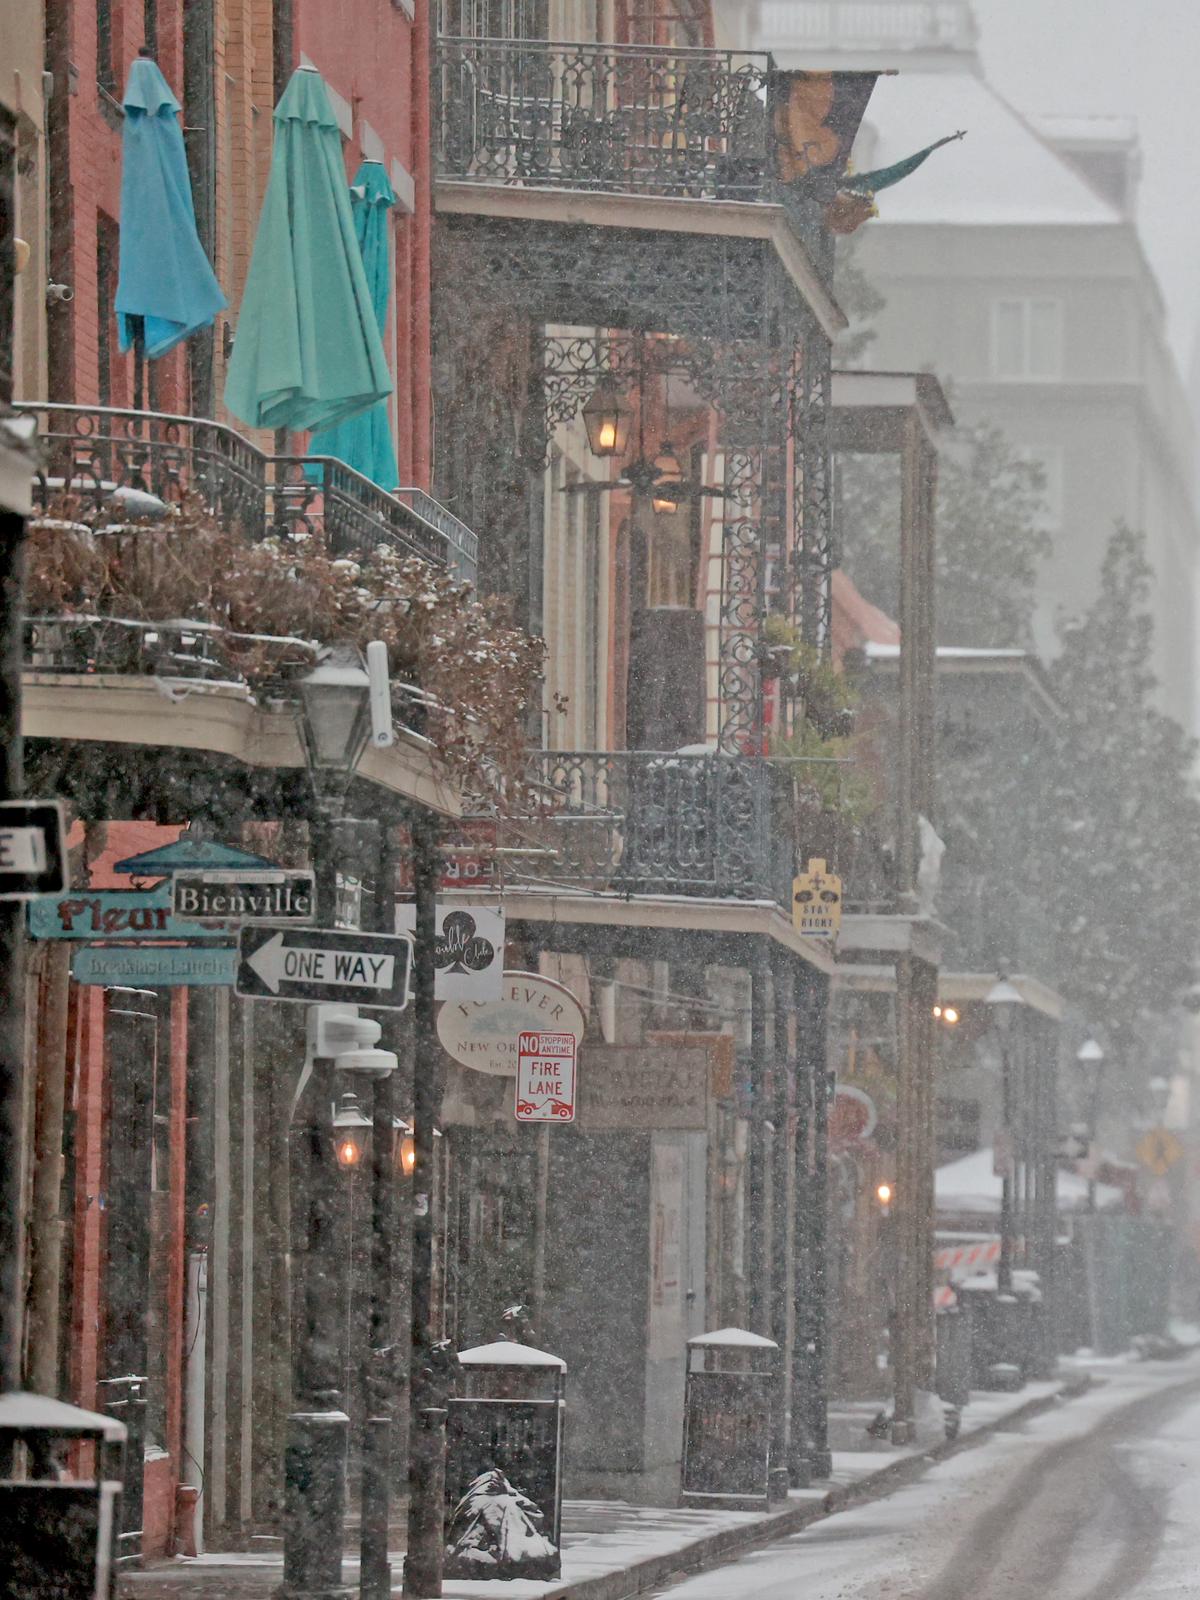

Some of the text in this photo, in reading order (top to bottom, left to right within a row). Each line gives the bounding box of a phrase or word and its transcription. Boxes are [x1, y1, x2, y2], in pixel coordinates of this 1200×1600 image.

[179, 887, 309, 912] Bienville
[57, 898, 172, 934] Fleur
[803, 904, 831, 914] STAY
[801, 918, 833, 928] RIGHT
[284, 950, 387, 984] ONE WAY
[457, 1041, 489, 1053] NEW
[520, 1036, 573, 1053] NO STOPPING
[541, 1045, 570, 1054] ANYTIME
[531, 1061, 561, 1076] FIRE
[528, 1081, 562, 1095] LANE
